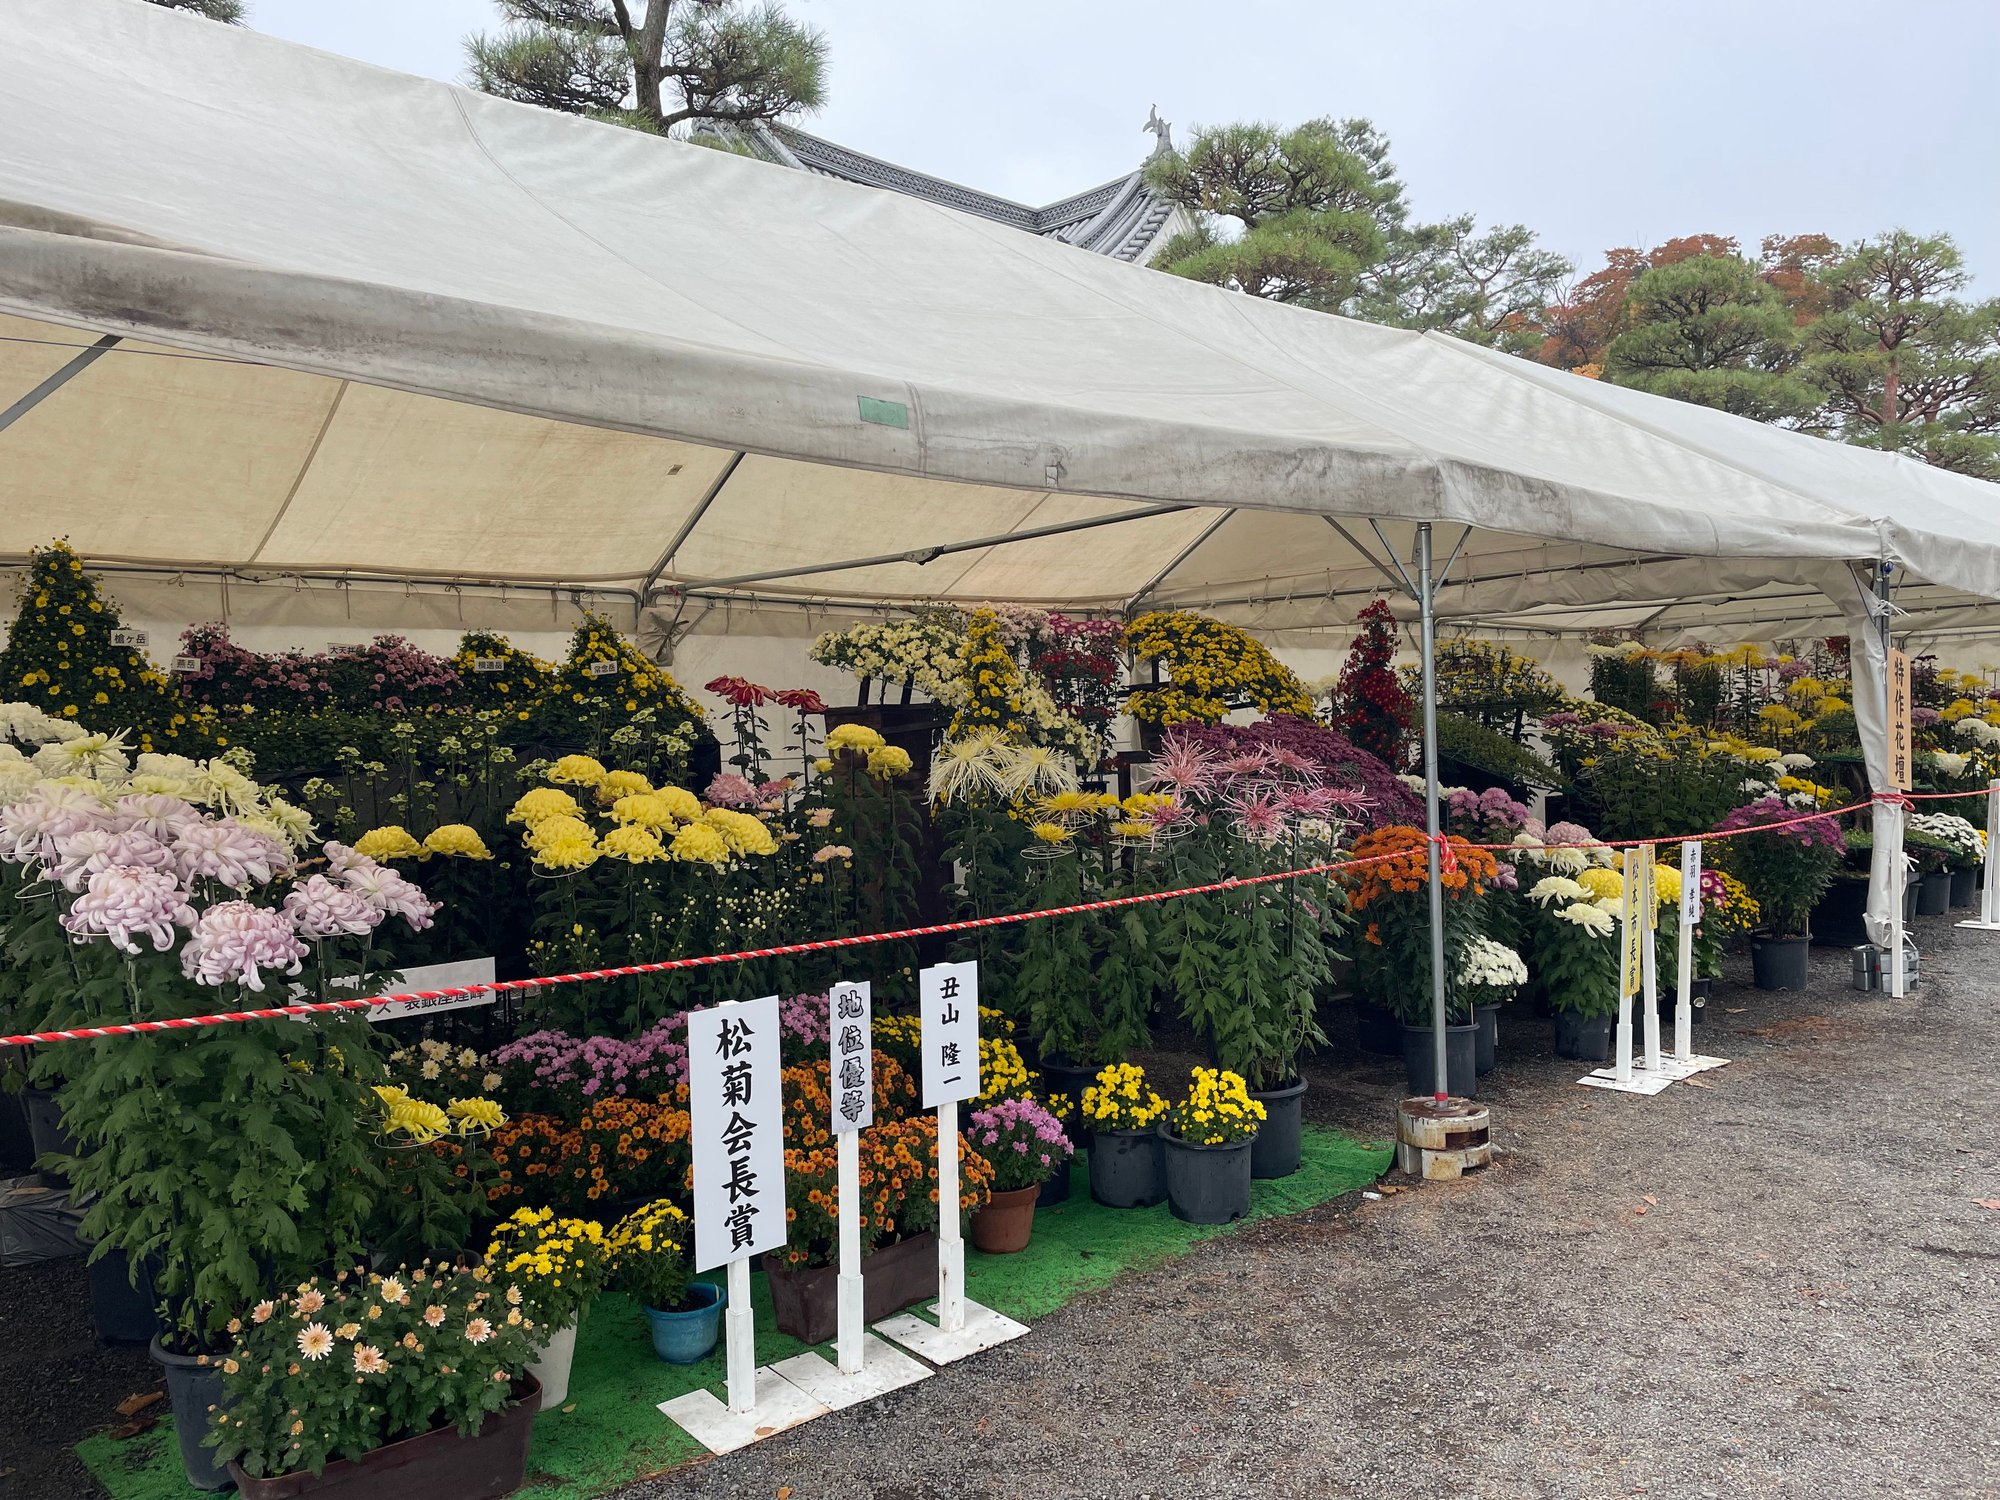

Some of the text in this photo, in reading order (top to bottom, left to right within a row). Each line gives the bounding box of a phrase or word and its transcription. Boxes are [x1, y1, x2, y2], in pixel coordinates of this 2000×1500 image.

[1894, 657, 1906, 784] 特作花壇
[1629, 858, 1639, 989] 松本市長賞
[838, 990, 865, 1122] 地位優等
[939, 976, 962, 1085] 丑山 隆一
[715, 1017, 760, 1253] 松菊会長賞
